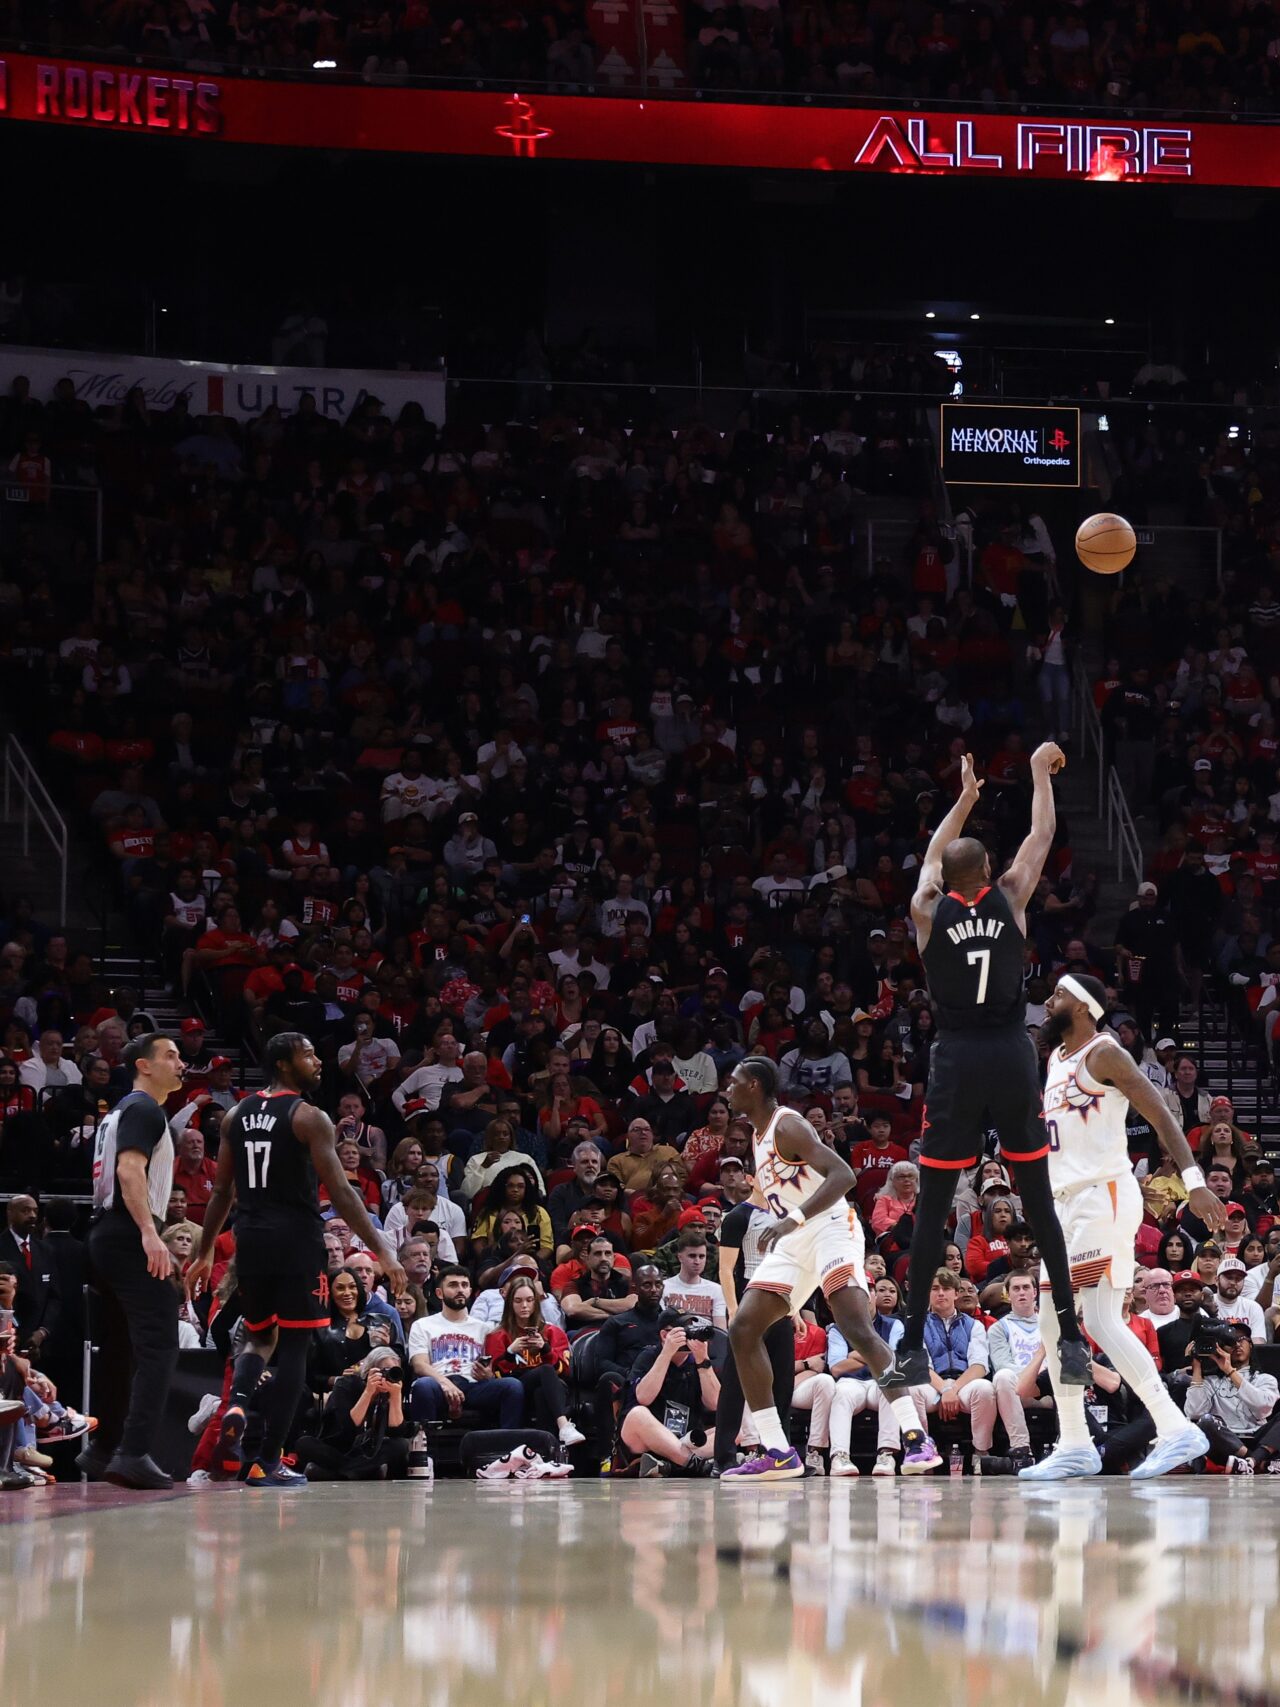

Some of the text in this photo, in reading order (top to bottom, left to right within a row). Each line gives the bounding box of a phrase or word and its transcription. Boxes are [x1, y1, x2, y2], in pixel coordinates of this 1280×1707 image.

[37, 64, 220, 133] ROCKETS
[854, 116, 1192, 176] ALL FIRE
[951, 427, 1038, 443] MEMORIAL
[951, 439, 1038, 454] HERMANN
[1023, 456, 1070, 466] Orthopedics
[946, 918, 1005, 945] DURANT
[967, 949, 990, 1004] 7
[242, 1113, 277, 1132] EASON
[244, 1140, 272, 1189] 17
